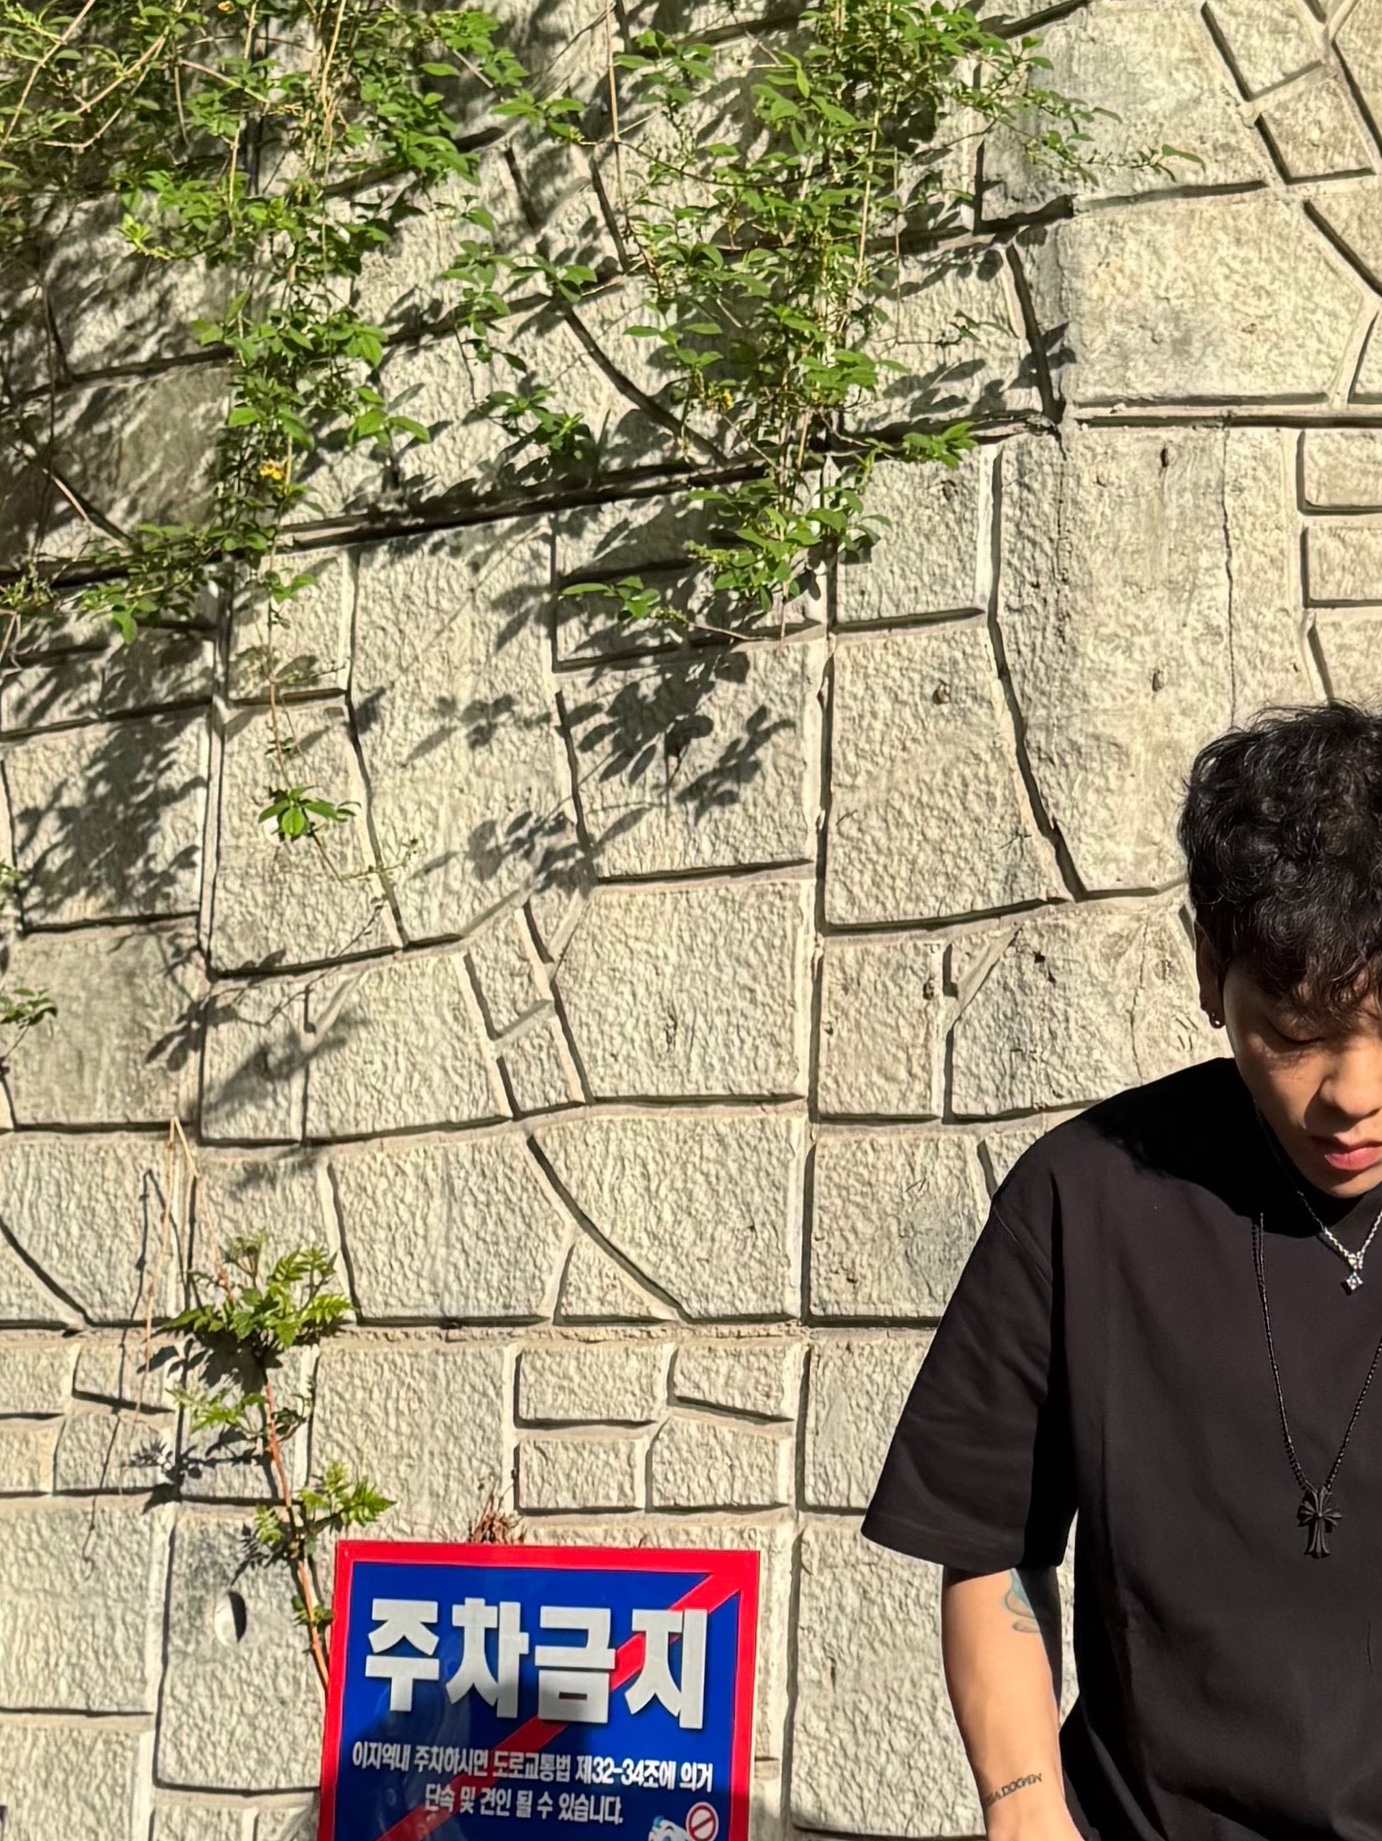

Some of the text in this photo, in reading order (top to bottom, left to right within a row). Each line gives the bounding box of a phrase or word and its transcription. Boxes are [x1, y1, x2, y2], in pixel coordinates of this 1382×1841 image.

[365, 1597, 708, 1730] 주차금지
[352, 1741, 411, 1771] 이지역내
[493, 1751, 571, 1783] 도로교통법
[575, 1755, 676, 1790] 제32-34조에
[679, 1762, 713, 1792] 의거
[425, 1783, 455, 1813] 단속
[460, 1786, 476, 1814] 및
[480, 1787, 511, 1817] 견인
[537, 1791, 553, 1819] 수
[558, 1792, 623, 1825] 있습니다.
